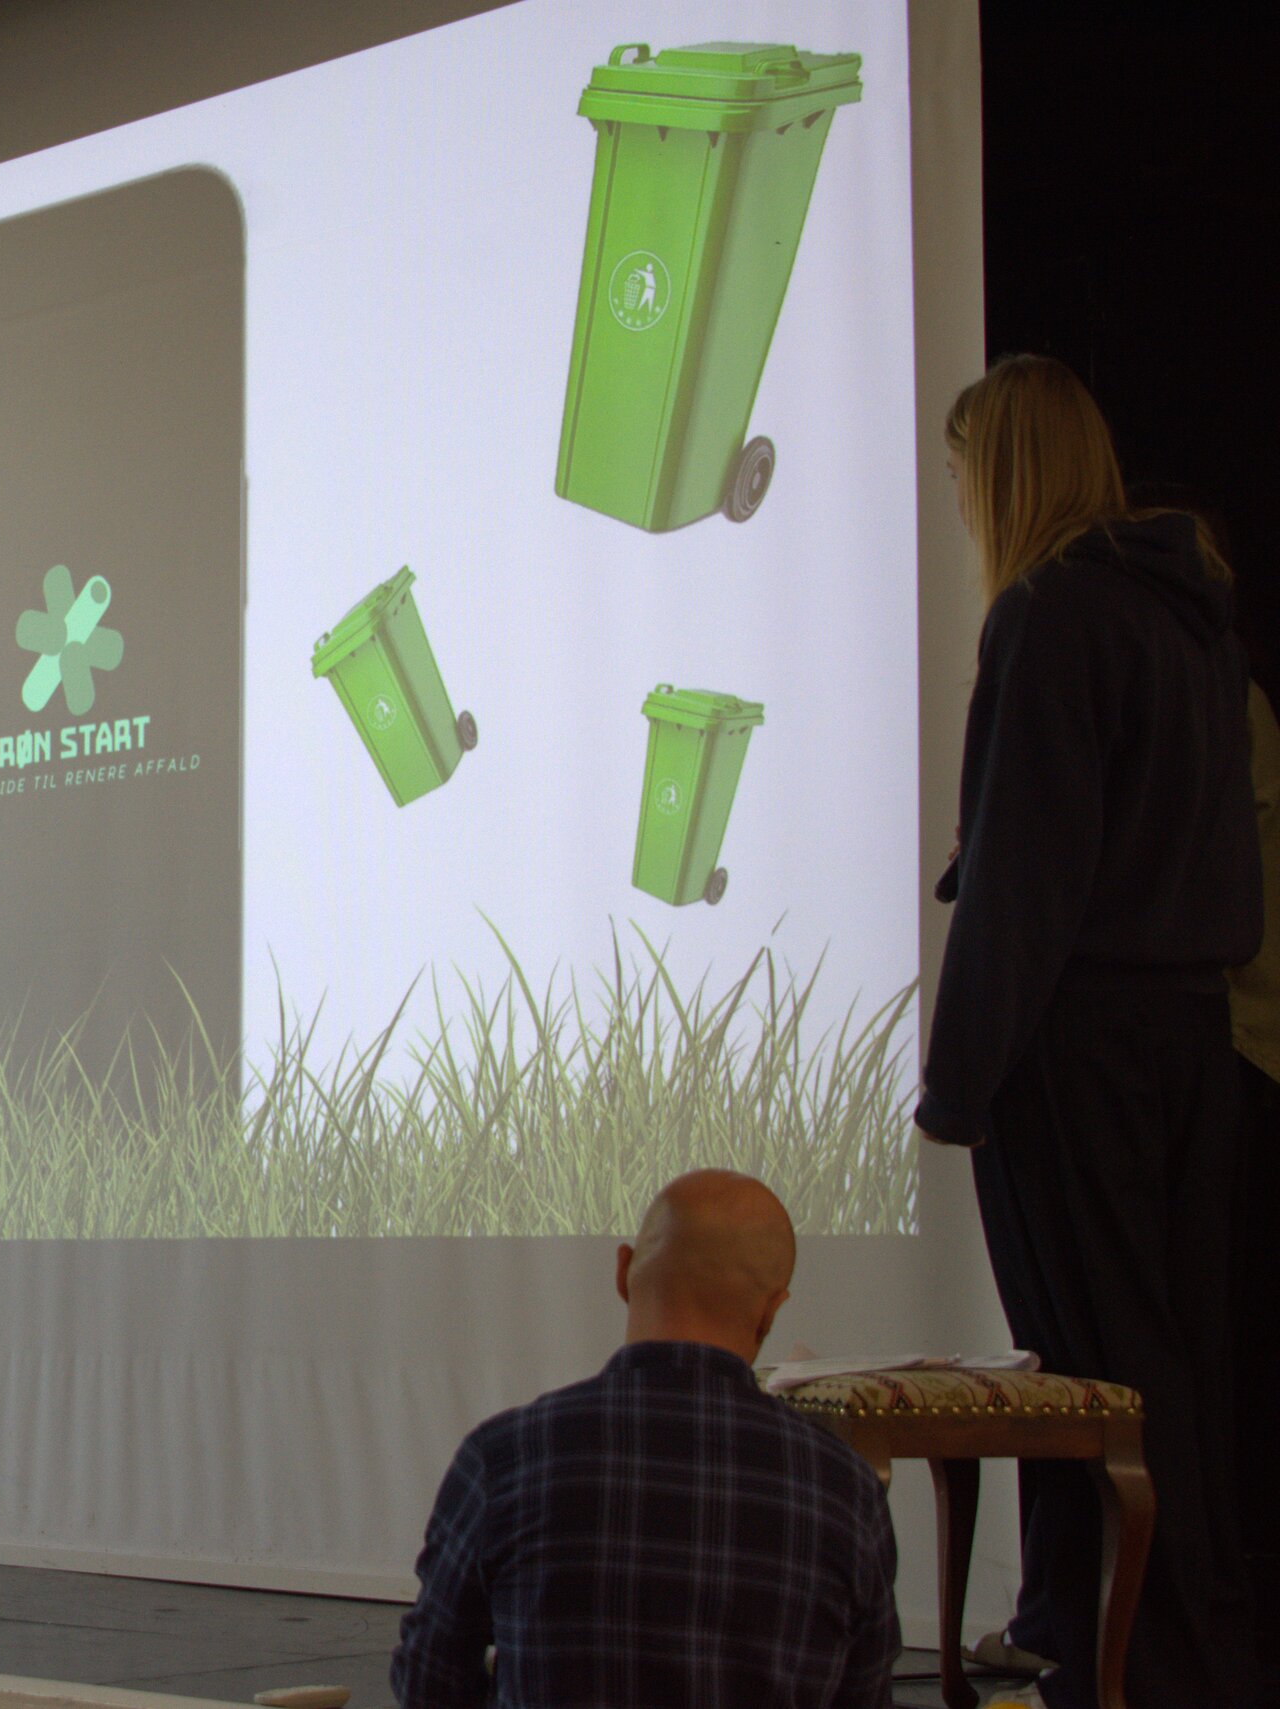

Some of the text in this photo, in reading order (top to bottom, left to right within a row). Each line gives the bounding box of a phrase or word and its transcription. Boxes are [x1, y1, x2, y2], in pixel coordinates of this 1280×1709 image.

[60, 715, 151, 759] START
[33, 774, 56, 790] TIL
[65, 764, 127, 786] RENERE
[135, 754, 201, 776] AFFALD
